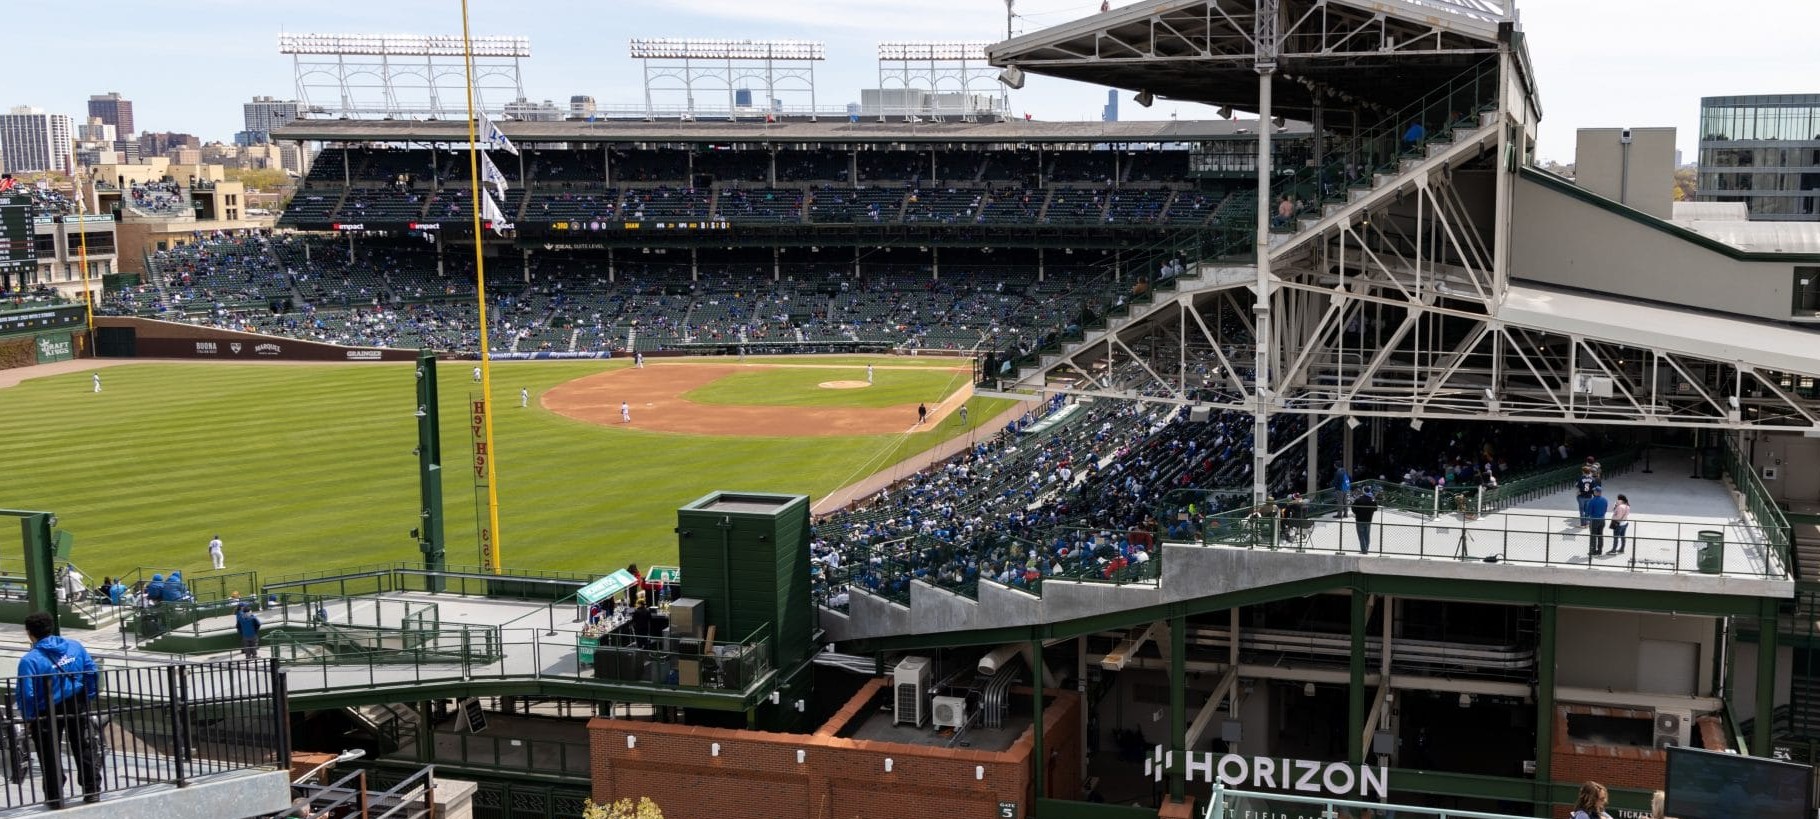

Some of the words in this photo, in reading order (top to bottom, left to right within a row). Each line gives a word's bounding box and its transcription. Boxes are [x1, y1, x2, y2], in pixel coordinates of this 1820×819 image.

[45, 348, 69, 357] KINGS
[1773, 751, 1791, 760] 5A
[1186, 751, 1388, 797] HORIZON
[1002, 808, 1013, 818] 5
